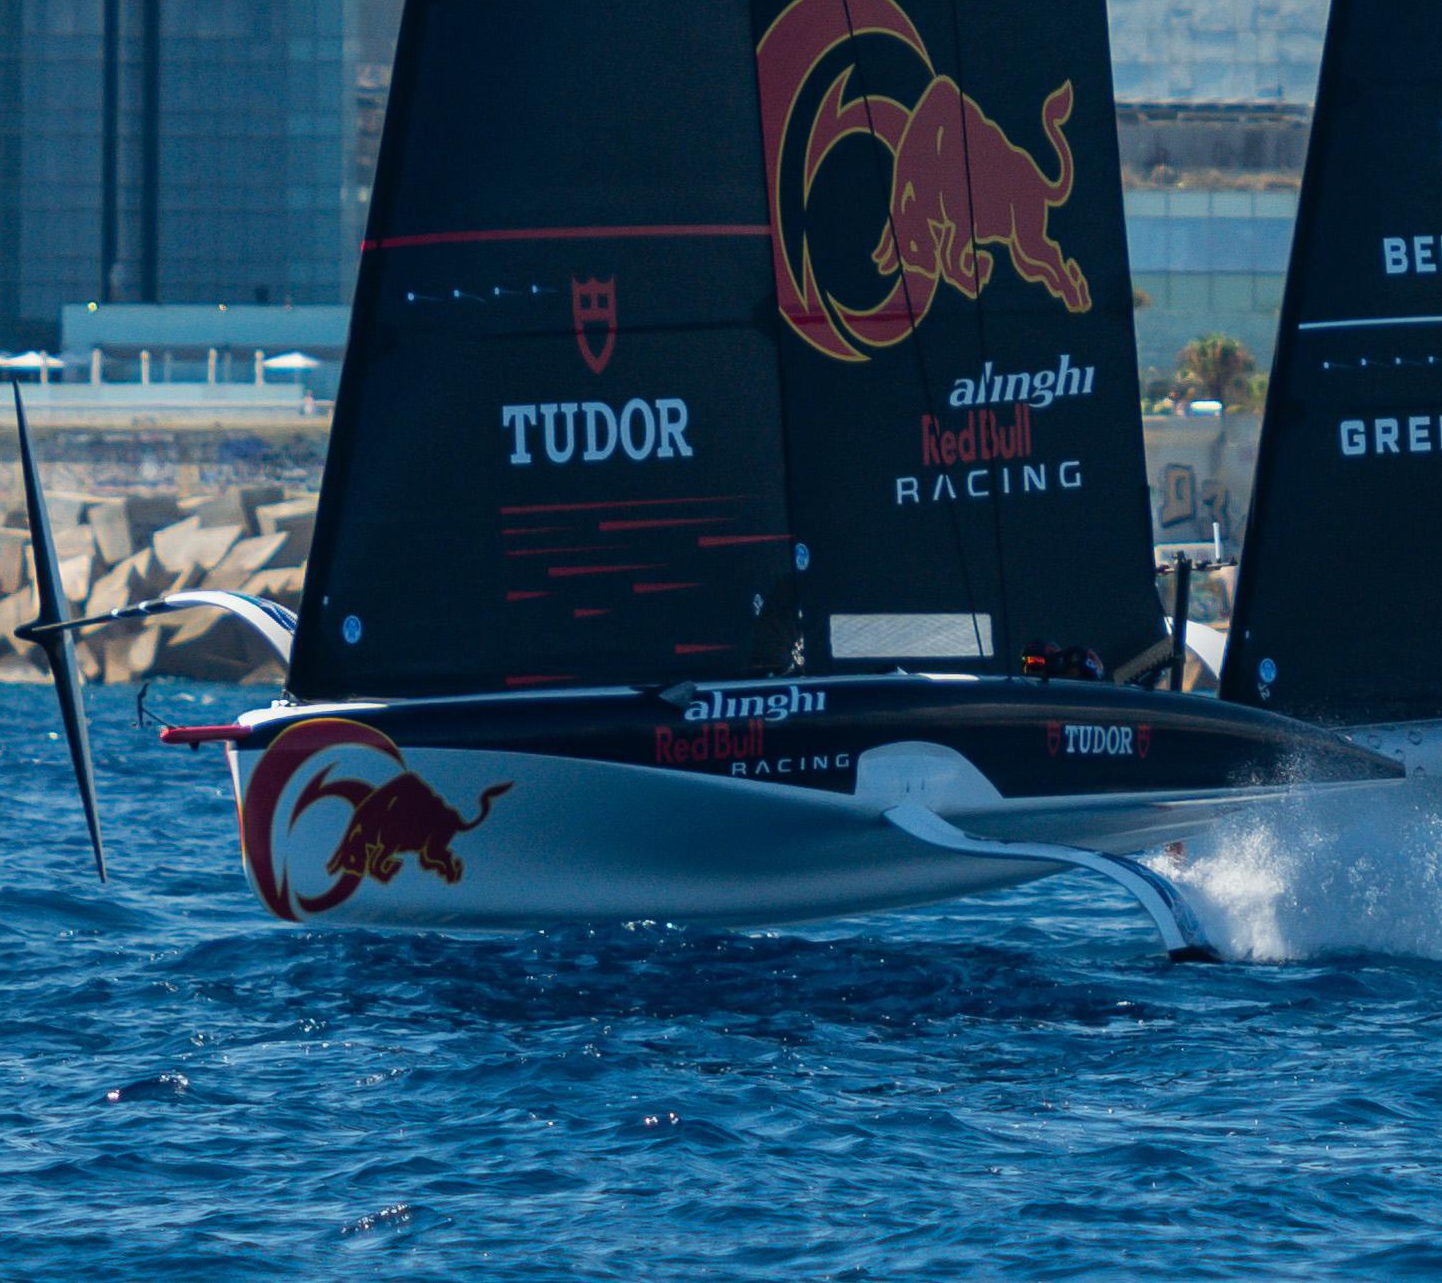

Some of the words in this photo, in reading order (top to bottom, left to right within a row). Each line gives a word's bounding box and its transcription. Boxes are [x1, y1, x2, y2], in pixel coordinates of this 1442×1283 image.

[949, 354, 1095, 408] alinghi
[502, 397, 694, 465] TUDOR
[895, 460, 1082, 505] RACING
[683, 685, 826, 722] alinghi
[654, 724, 710, 764] Red
[714, 718, 764, 760] Bull
[1064, 724, 1133, 755] TUDOR
[731, 754, 850, 777] RACING
